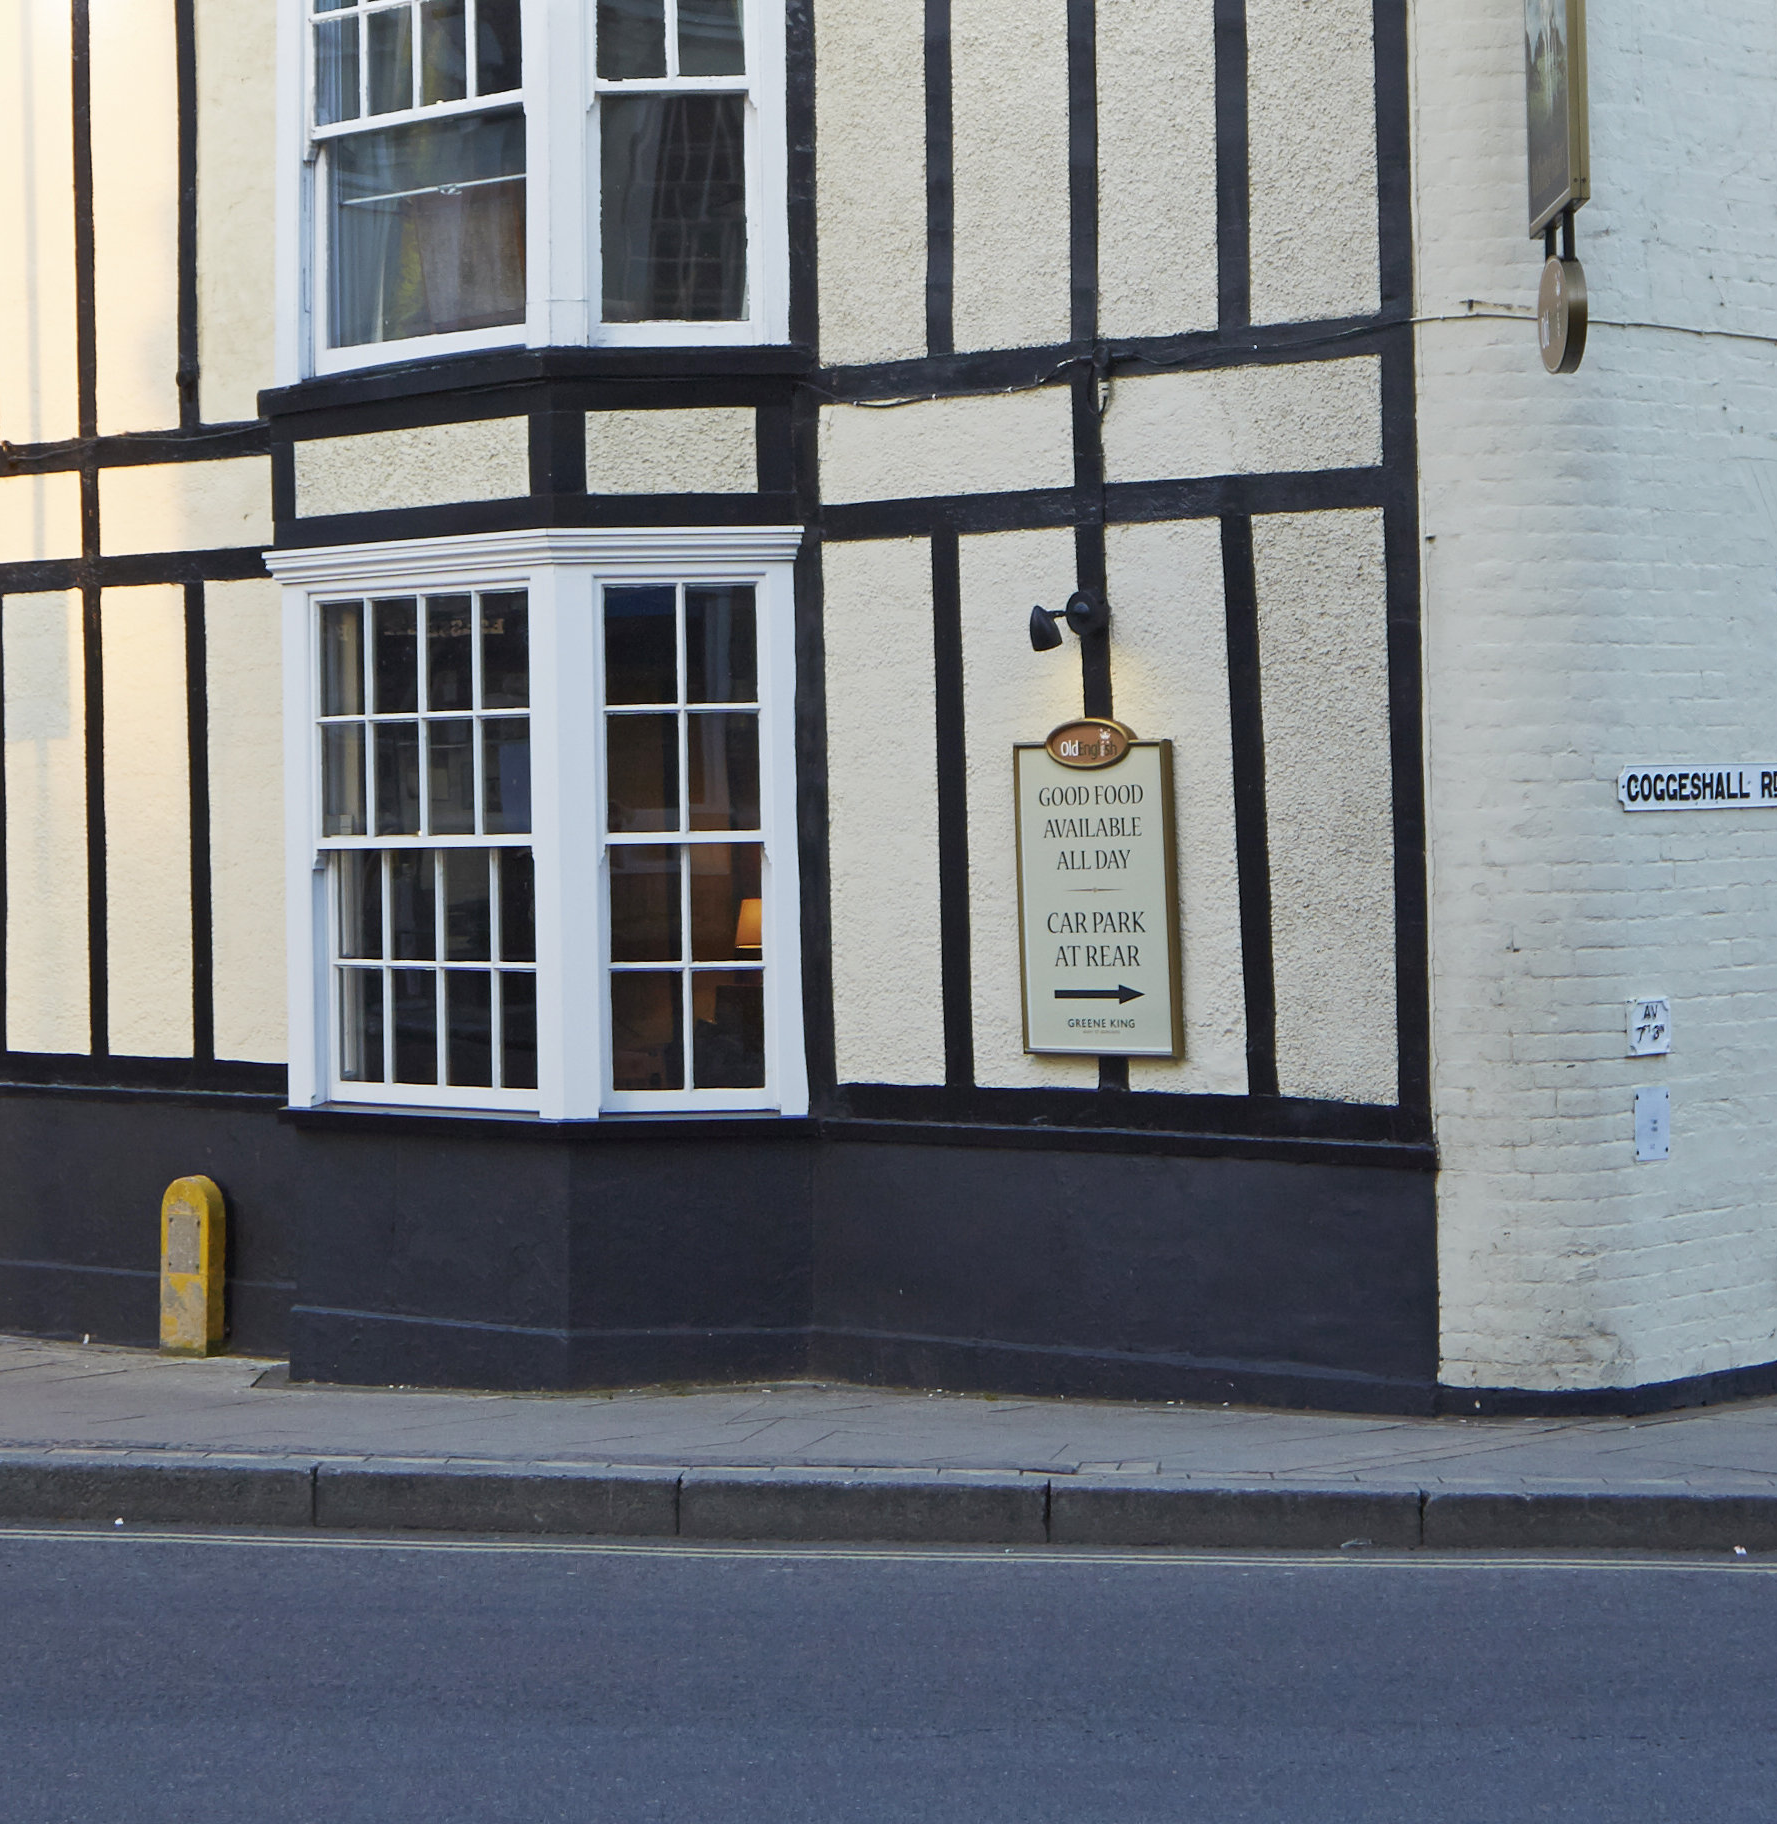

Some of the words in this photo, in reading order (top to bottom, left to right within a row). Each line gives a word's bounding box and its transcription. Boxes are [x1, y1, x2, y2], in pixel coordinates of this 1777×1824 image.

[1039, 787, 1090, 806] GOOD
[1094, 784, 1143, 805] FOOD
[1627, 772, 1751, 802] COGGESHALL
[1043, 817, 1142, 838] AVAILABLE
[1057, 850, 1091, 870] ALL
[1095, 849, 1131, 869] DAY
[1047, 912, 1088, 933] CAR
[1092, 911, 1146, 933] PARK
[1055, 945, 1081, 967] AT
[1086, 945, 1141, 967] REAR
[1067, 1019, 1106, 1029] GREENE
[1110, 1019, 1135, 1029] KING
